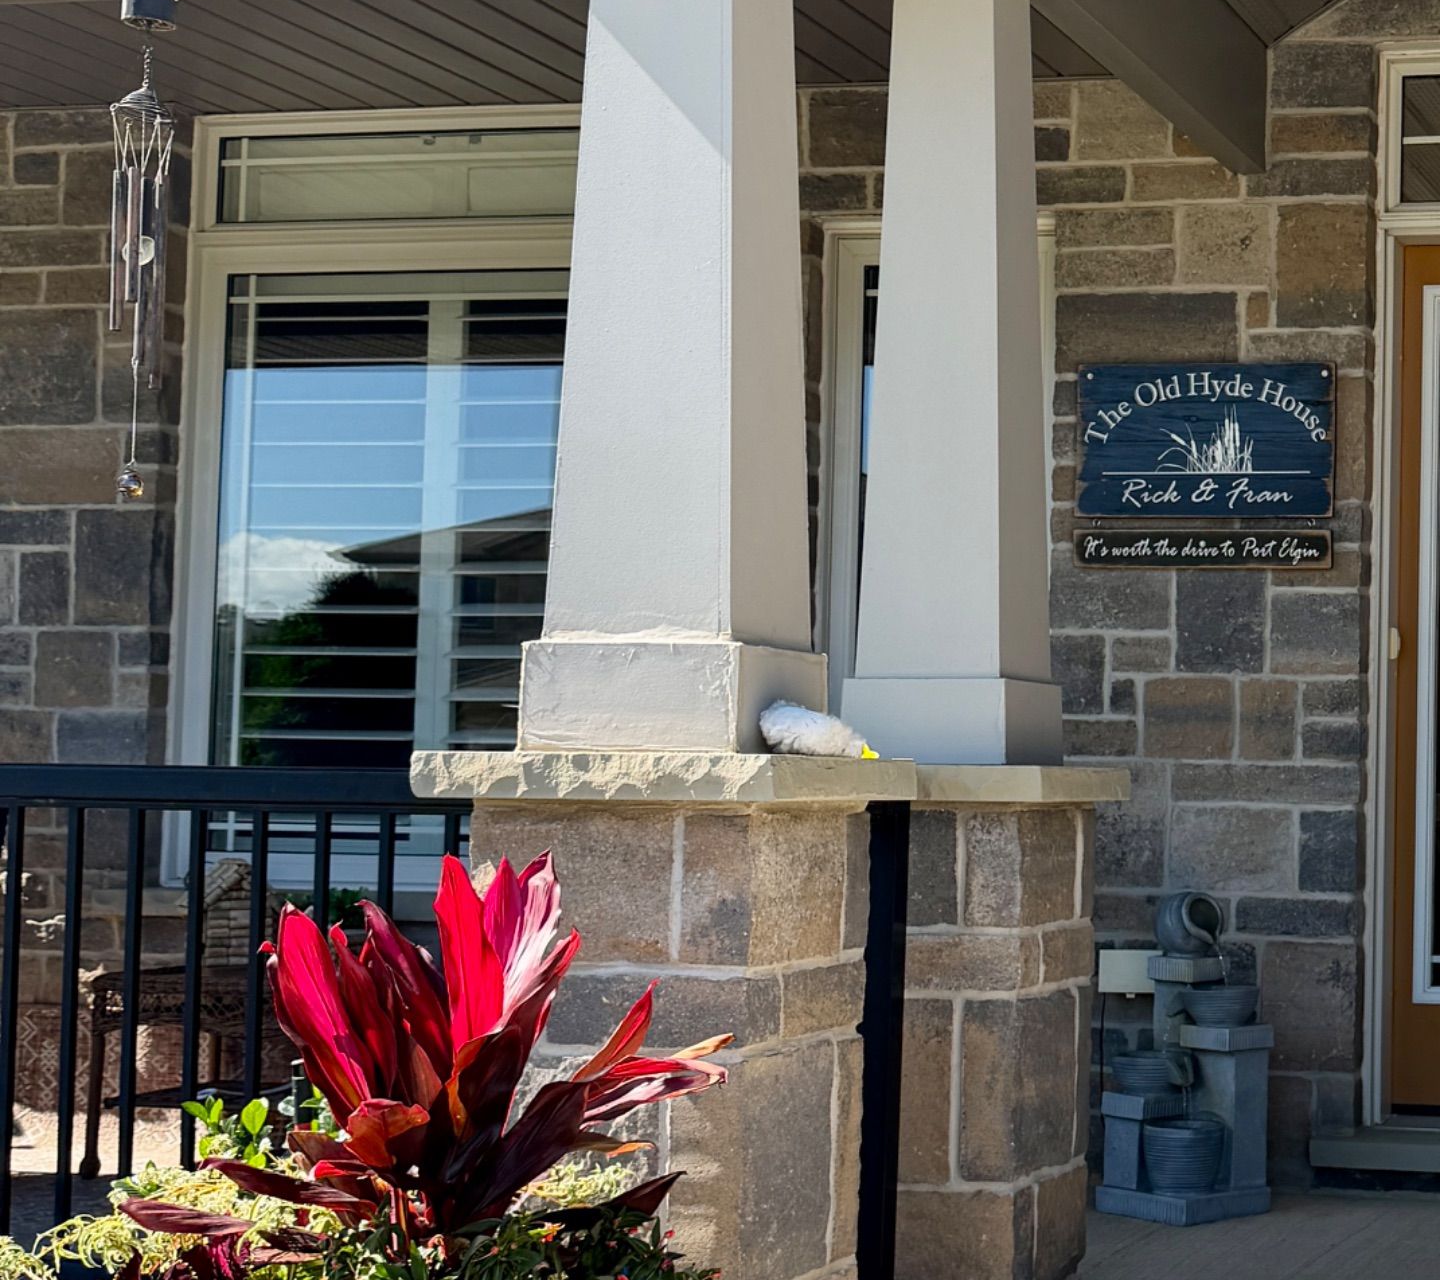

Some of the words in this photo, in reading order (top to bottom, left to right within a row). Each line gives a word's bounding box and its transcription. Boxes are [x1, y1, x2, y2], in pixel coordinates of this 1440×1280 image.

[1084, 401, 1133, 445] The
[1134, 375, 1182, 408] Old
[1186, 371, 1254, 402] Hyde
[1257, 377, 1328, 443] House
[1121, 477, 1182, 509] Rick
[1190, 477, 1219, 504] &
[1225, 477, 1294, 510] Fran
[1084, 535, 1110, 558] It's
[1111, 537, 1152, 558] worth
[1153, 538, 1178, 557] the
[1181, 538, 1219, 558] drive
[1219, 539, 1236, 558] to
[1241, 536, 1277, 558] Port
[1278, 536, 1321, 566] Elgin
